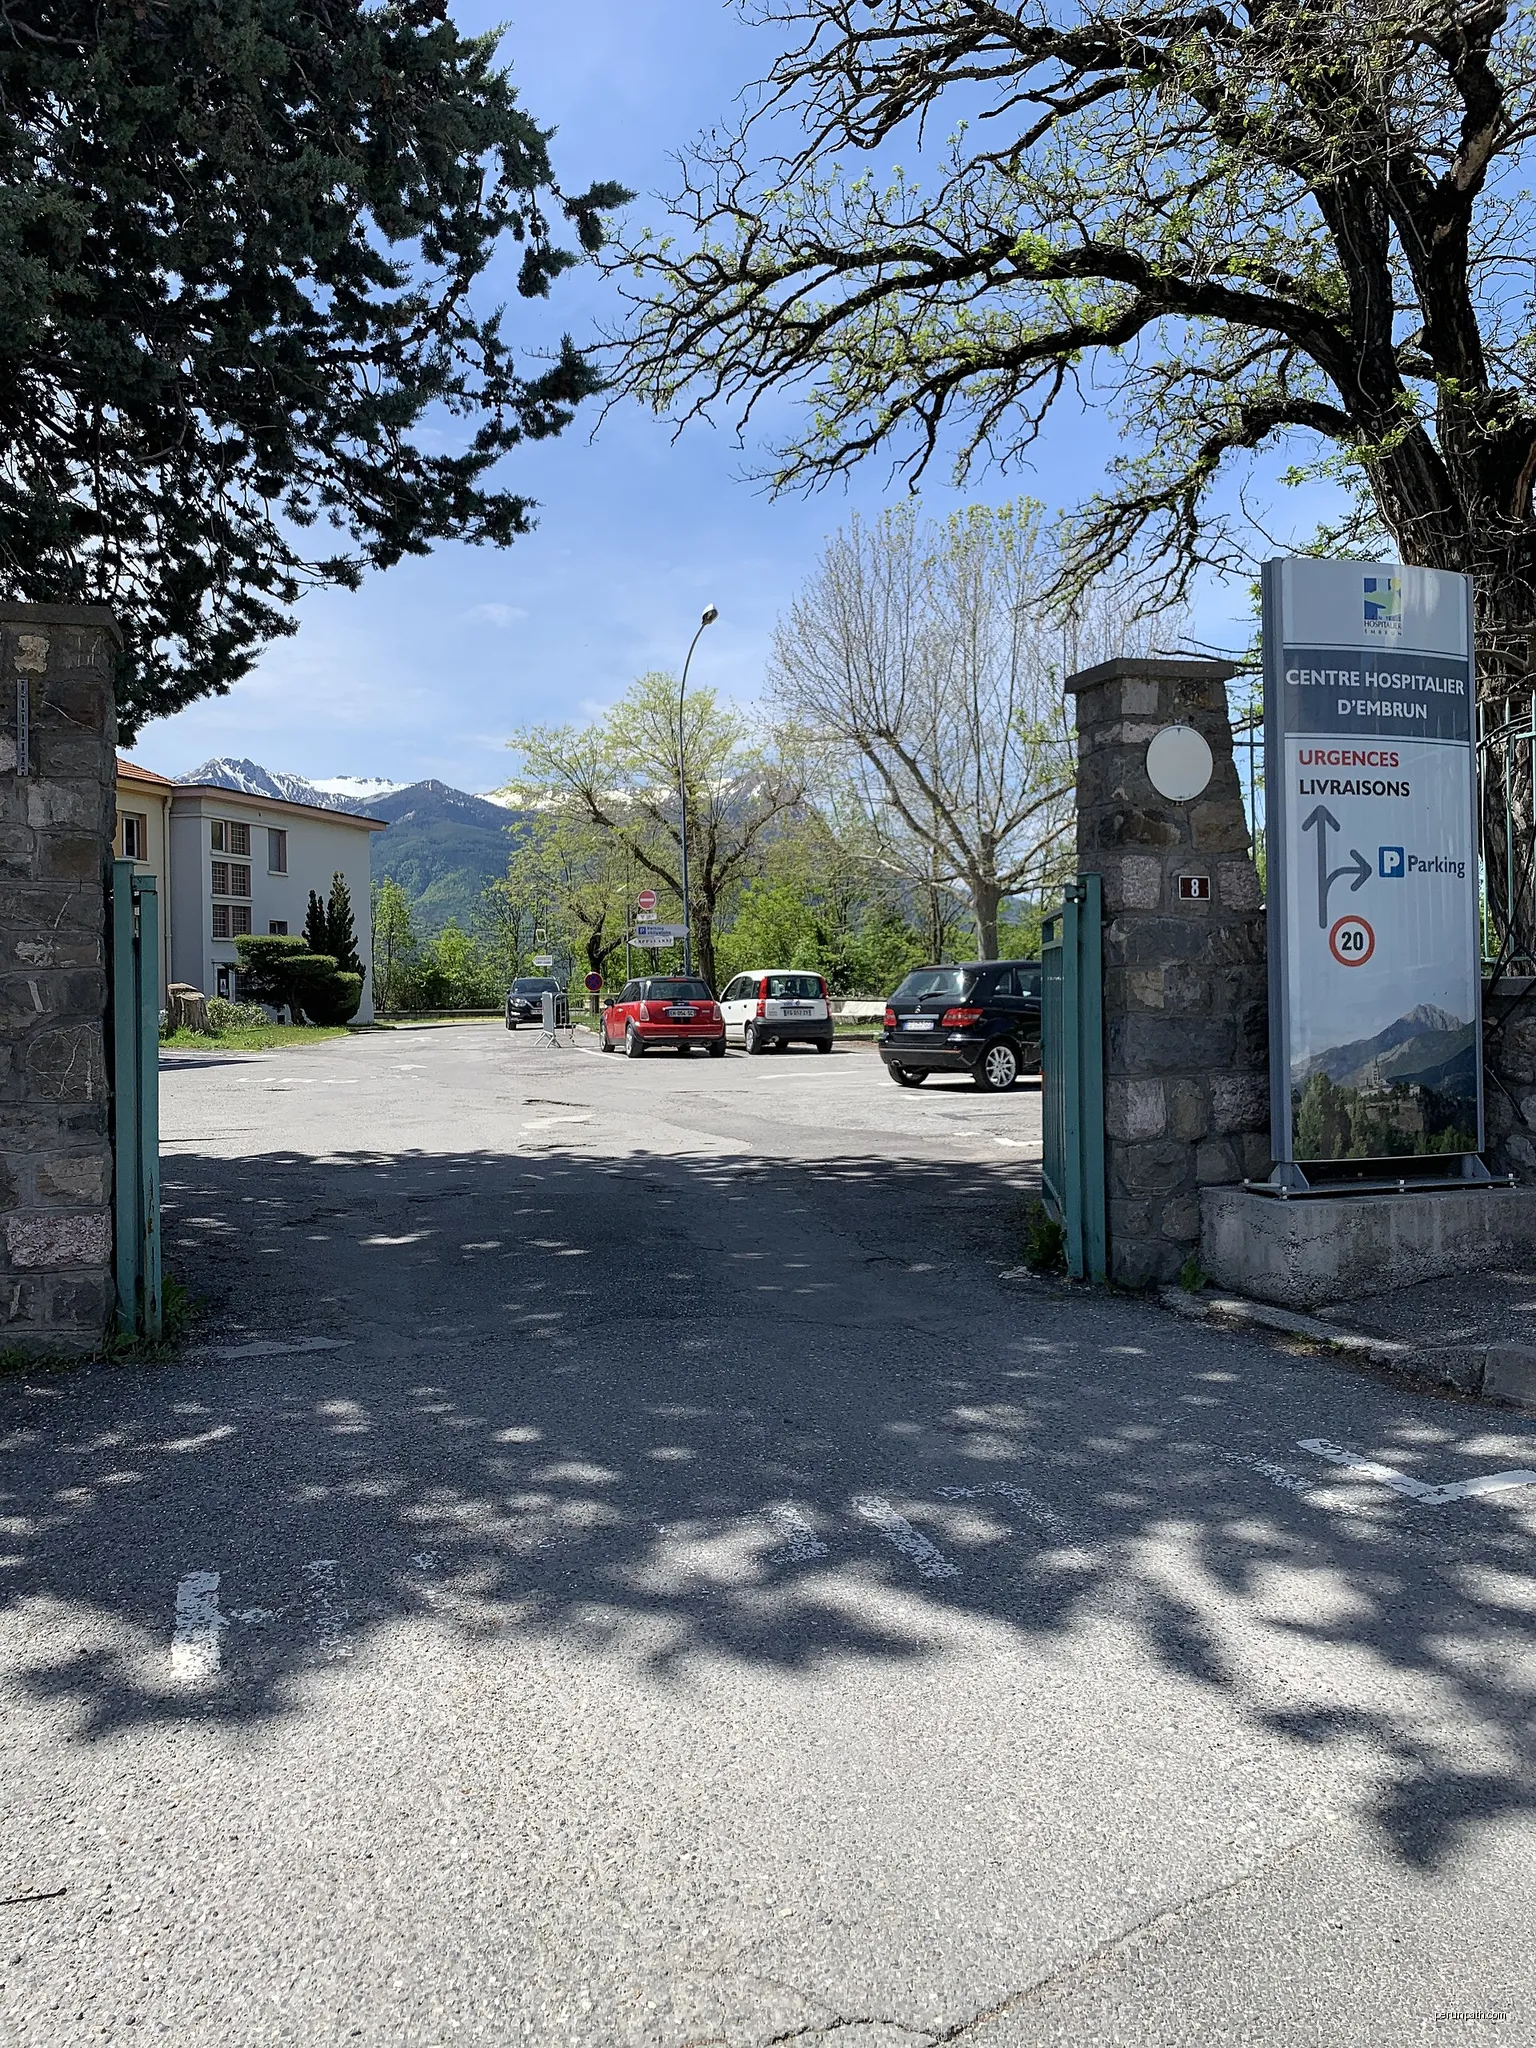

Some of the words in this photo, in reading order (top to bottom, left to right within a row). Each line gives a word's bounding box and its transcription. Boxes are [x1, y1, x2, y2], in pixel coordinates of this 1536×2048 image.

[1286, 668, 1360, 687] CENTRE
[1365, 671, 1464, 695] HOSPITALIER
[1298, 750, 1399, 768] URGENCES
[1299, 779, 1410, 797] LIVRAISONS
[1384, 851, 1400, 873] P
[1408, 854, 1466, 879] Parking
[1191, 878, 1200, 897] 8
[1341, 931, 1364, 951] 20
